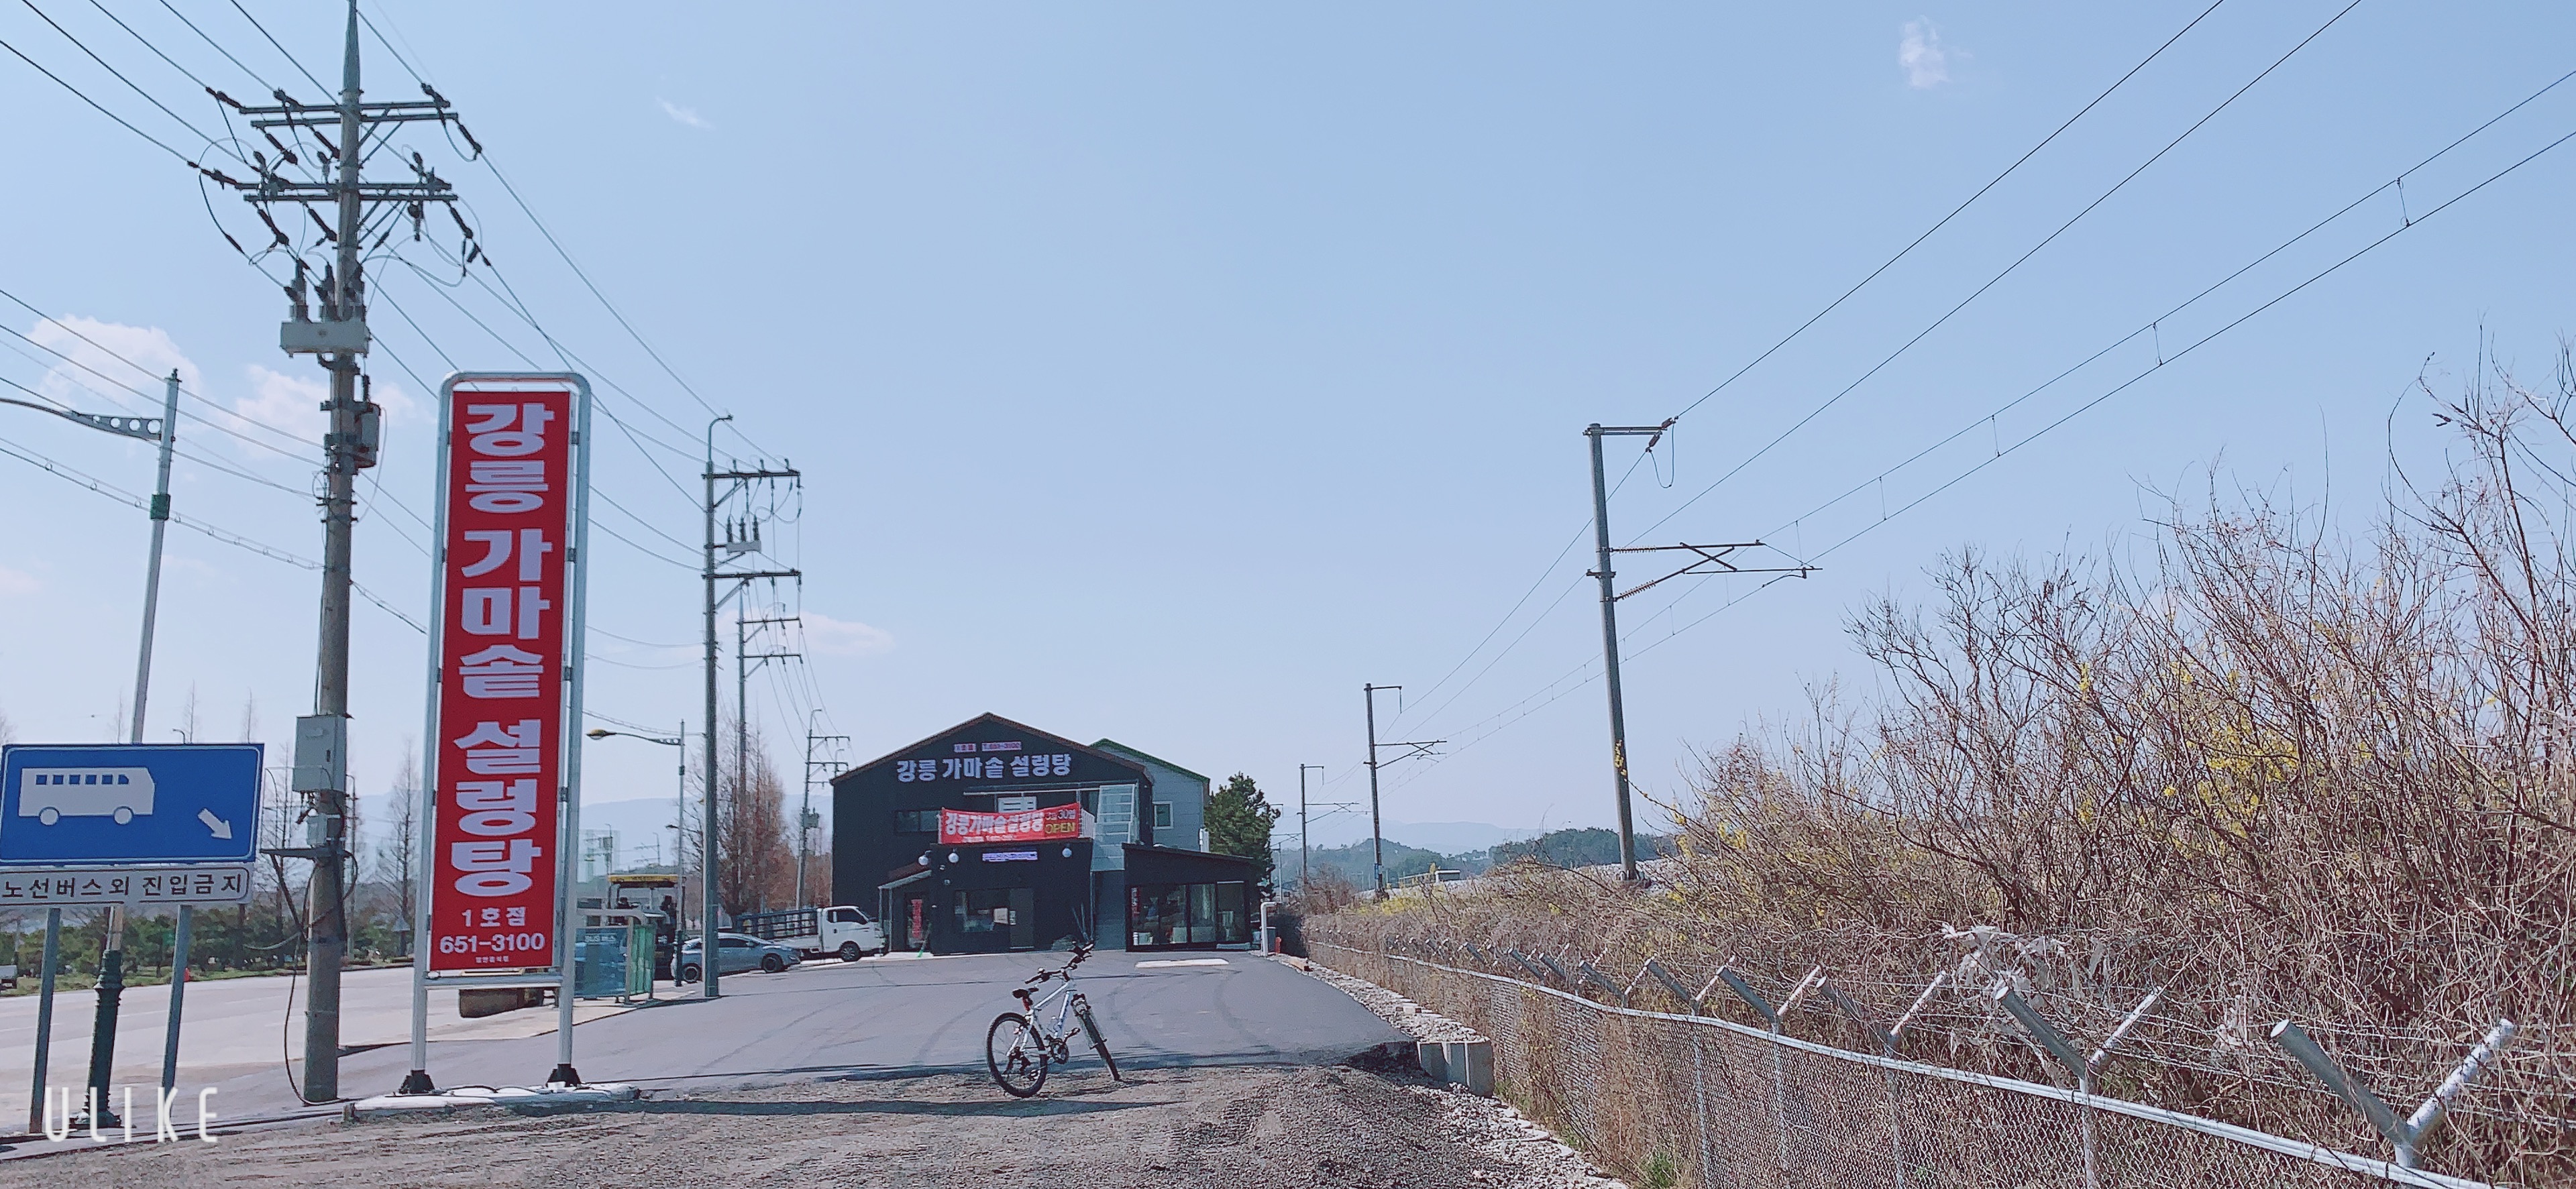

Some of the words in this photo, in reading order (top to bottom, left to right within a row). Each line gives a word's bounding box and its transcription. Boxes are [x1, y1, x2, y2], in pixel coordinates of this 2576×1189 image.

[464, 402, 555, 514] 강릉
[459, 528, 553, 699] 가마솥
[897, 759, 937, 783] 강릉
[942, 756, 1004, 780] 가마솥
[1010, 753, 1072, 778] 설렁탕
[451, 718, 542, 897] 설렁탕
[1044, 822, 1076, 834] OPEN
[142, 873, 241, 897] 진입금지
[439, 932, 545, 954] 651-3100
